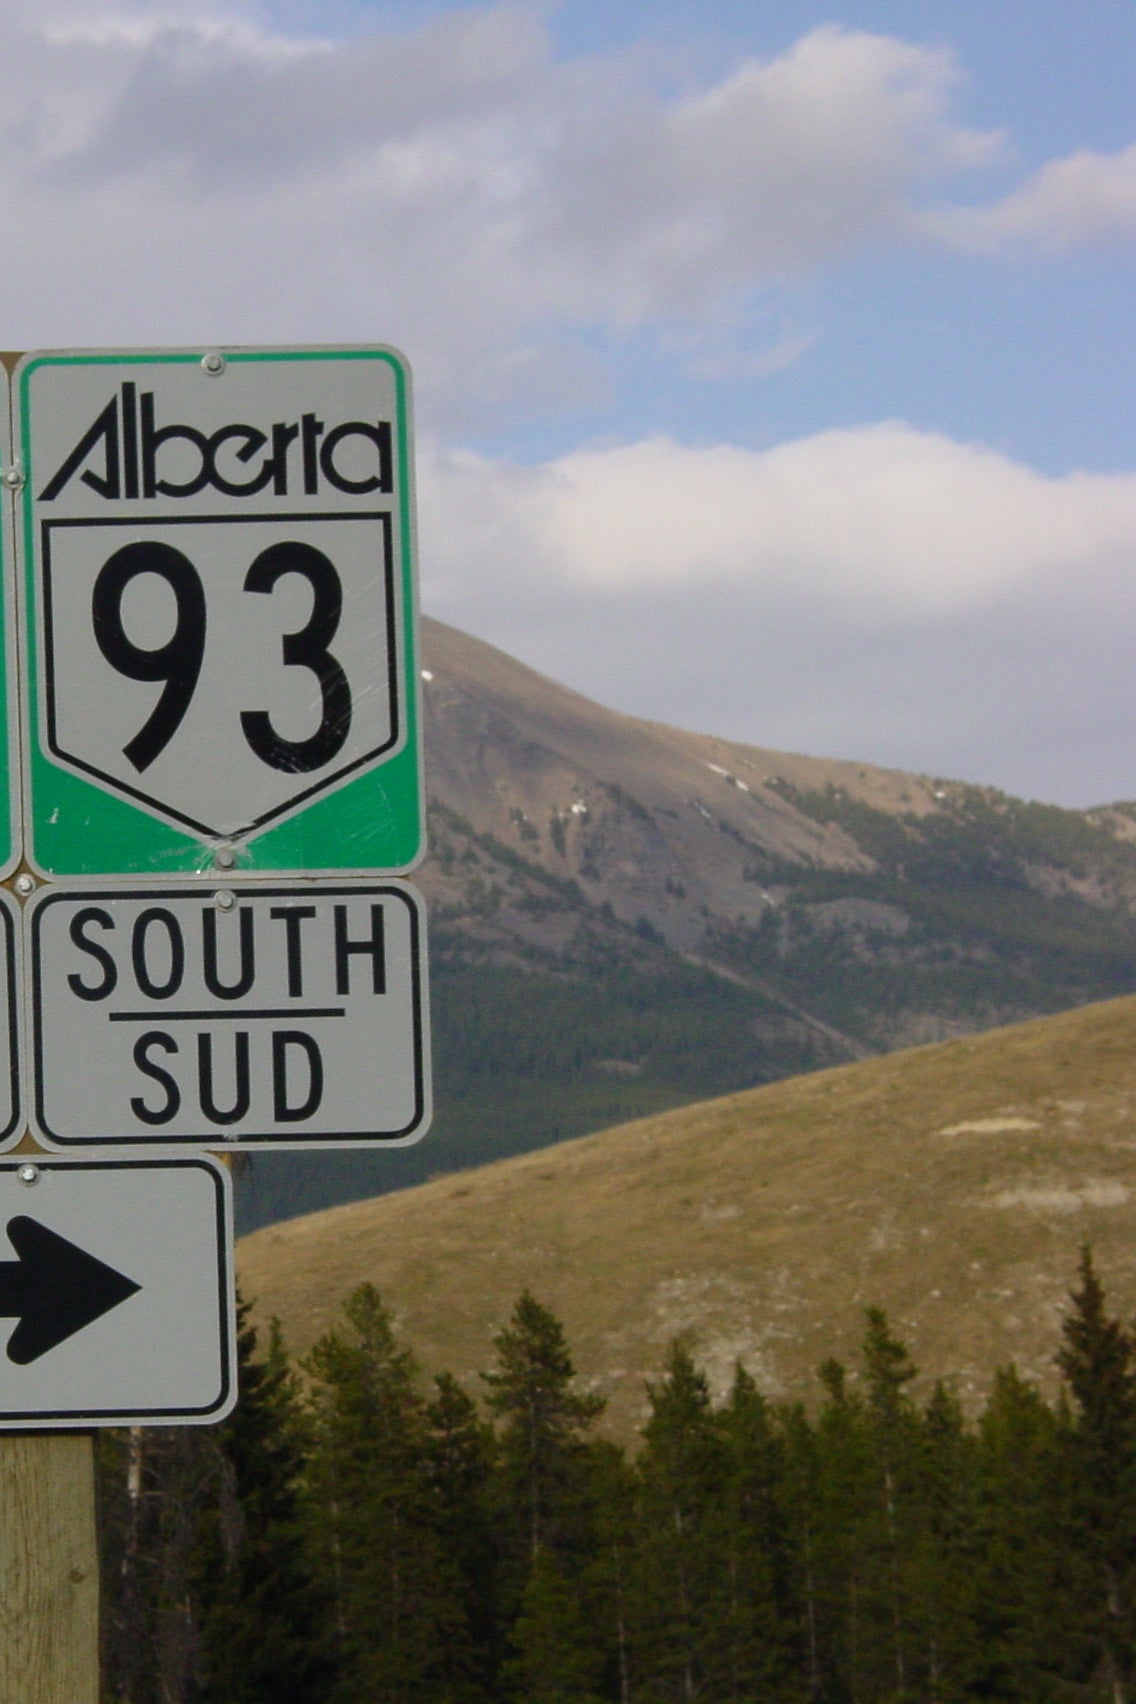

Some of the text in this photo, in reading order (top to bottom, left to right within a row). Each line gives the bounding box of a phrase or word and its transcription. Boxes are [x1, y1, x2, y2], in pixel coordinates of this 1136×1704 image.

[37, 382, 394, 501] Alberta
[91, 540, 353, 775] 93
[67, 904, 387, 1002] SOUTH
[130, 1030, 324, 1126] SUD
